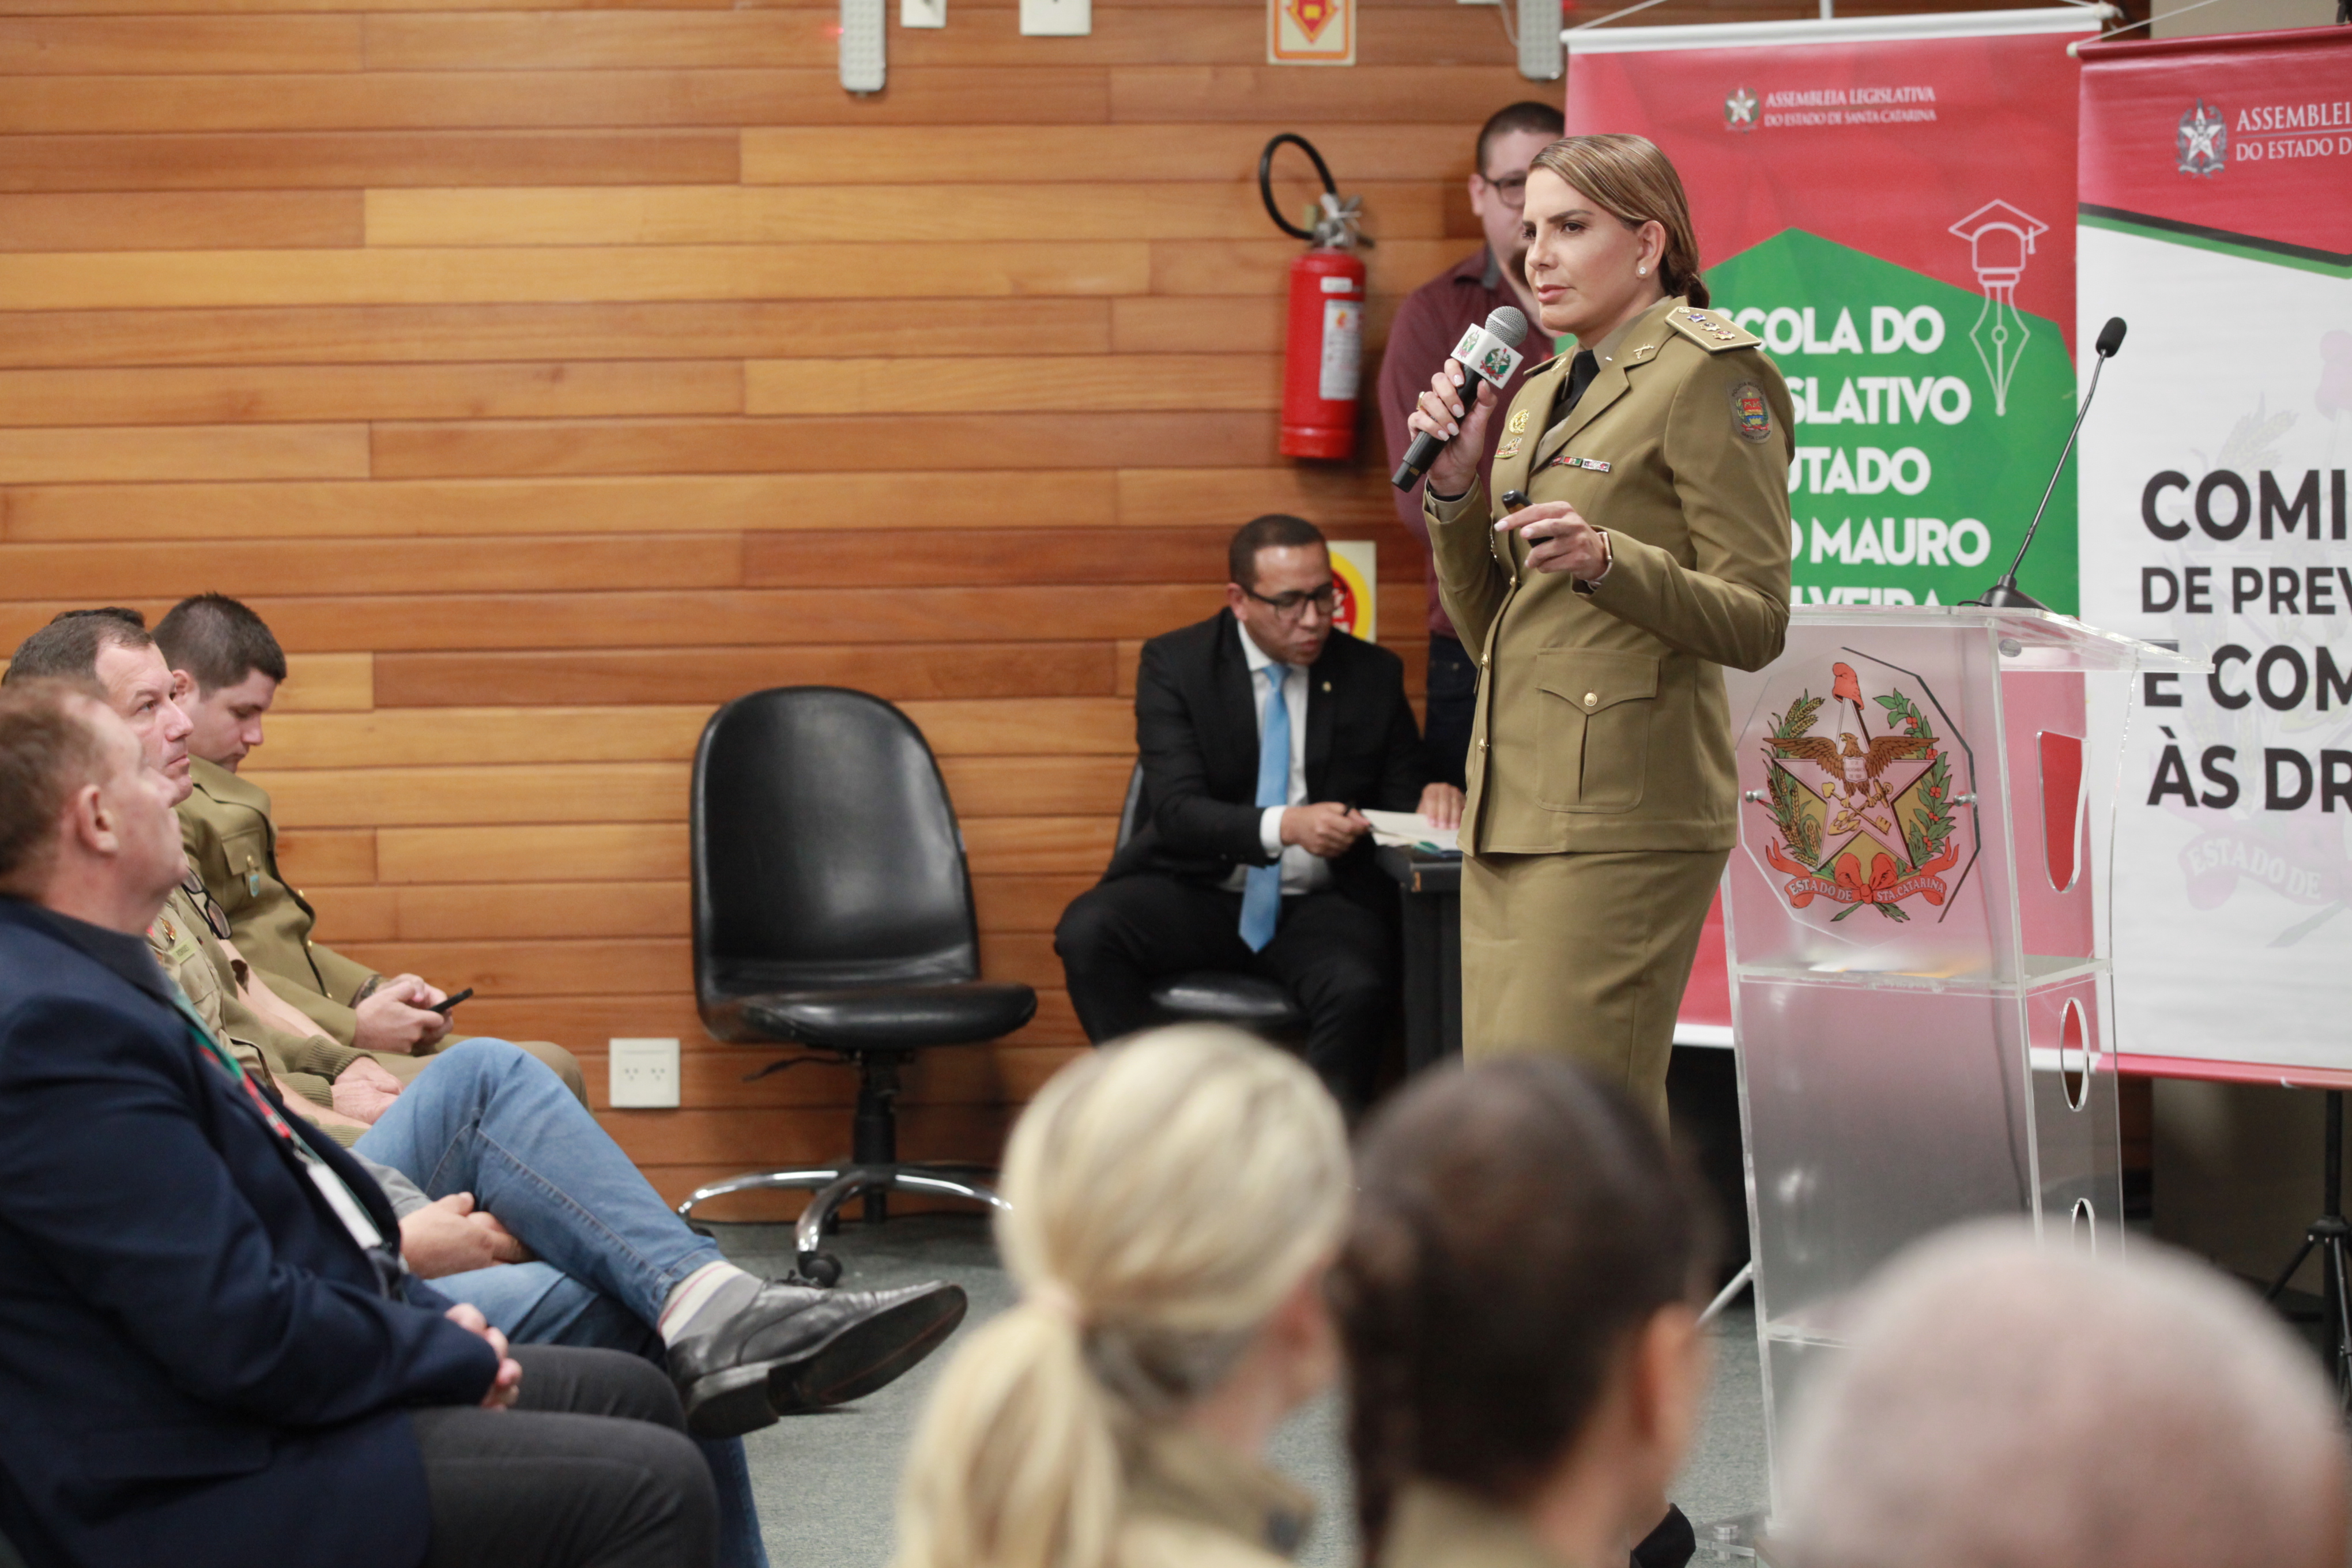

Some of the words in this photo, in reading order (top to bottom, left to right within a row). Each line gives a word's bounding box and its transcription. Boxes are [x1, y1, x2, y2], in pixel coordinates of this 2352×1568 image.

[1764, 113, 1783, 127] DO
[1784, 111, 1826, 126] ESTADO
[1827, 111, 1842, 125] DE
[1844, 110, 1880, 125] SANTA
[1880, 108, 1937, 124] CATARINA
[1765, 89, 1845, 108] ASSEMBLEIA
[1849, 86, 1936, 105] LEGISLATIVA
[2236, 101, 2352, 131] ASSEMBLEI
[2236, 142, 2263, 161] DO
[2268, 137, 2334, 160] ESTADO
[1871, 304, 1946, 355] DO
[2141, 469, 2347, 541] COMI
[1810, 517, 1992, 567] MAURO
[2142, 567, 2213, 614] DE
[2140, 640, 2183, 707] E
[2147, 725, 2240, 809] ÀS
[1788, 879, 1836, 897] ESTADO
[1836, 888, 1853, 901] DE
[2187, 838, 2286, 884] ESTADO
[2286, 866, 2322, 900] DE
